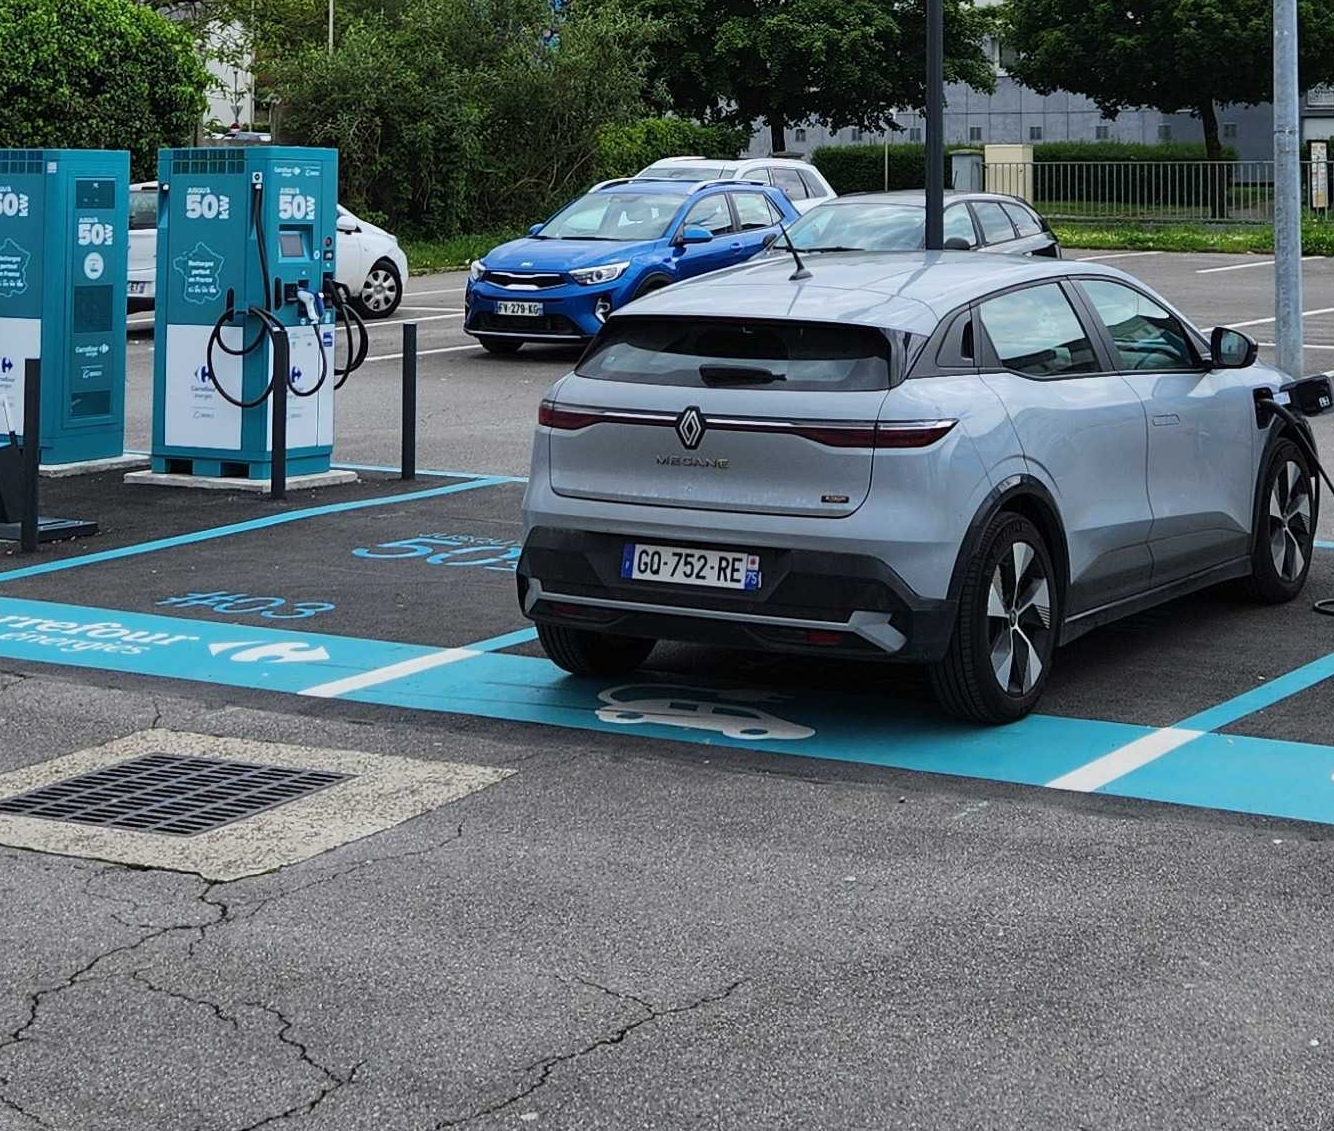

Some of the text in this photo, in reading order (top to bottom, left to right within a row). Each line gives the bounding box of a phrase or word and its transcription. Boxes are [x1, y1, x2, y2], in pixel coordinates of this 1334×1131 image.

[186, 194, 219, 219] 50
[278, 194, 306, 220] 50
[77, 223, 105, 246] 50
[637, 549, 744, 584] GQ-752-RE
